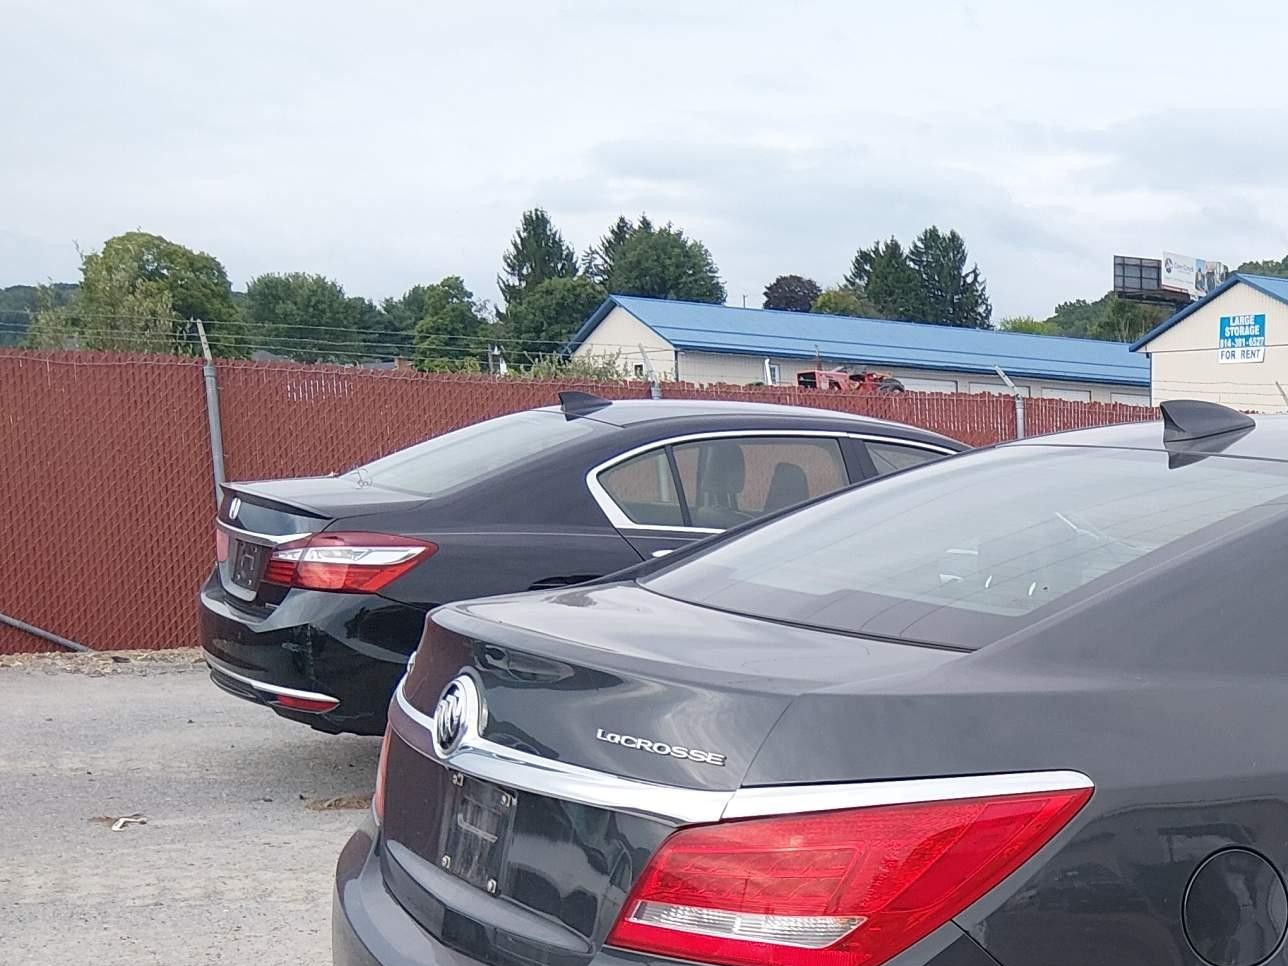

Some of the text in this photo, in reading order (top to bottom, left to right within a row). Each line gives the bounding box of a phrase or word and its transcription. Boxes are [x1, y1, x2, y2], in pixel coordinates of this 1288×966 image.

[1230, 315, 1255, 326] LARGE
[1225, 325, 1260, 337] STORAGE
[1221, 349, 1260, 360] FOR RENT
[596, 728, 727, 767] LaCROSSE
